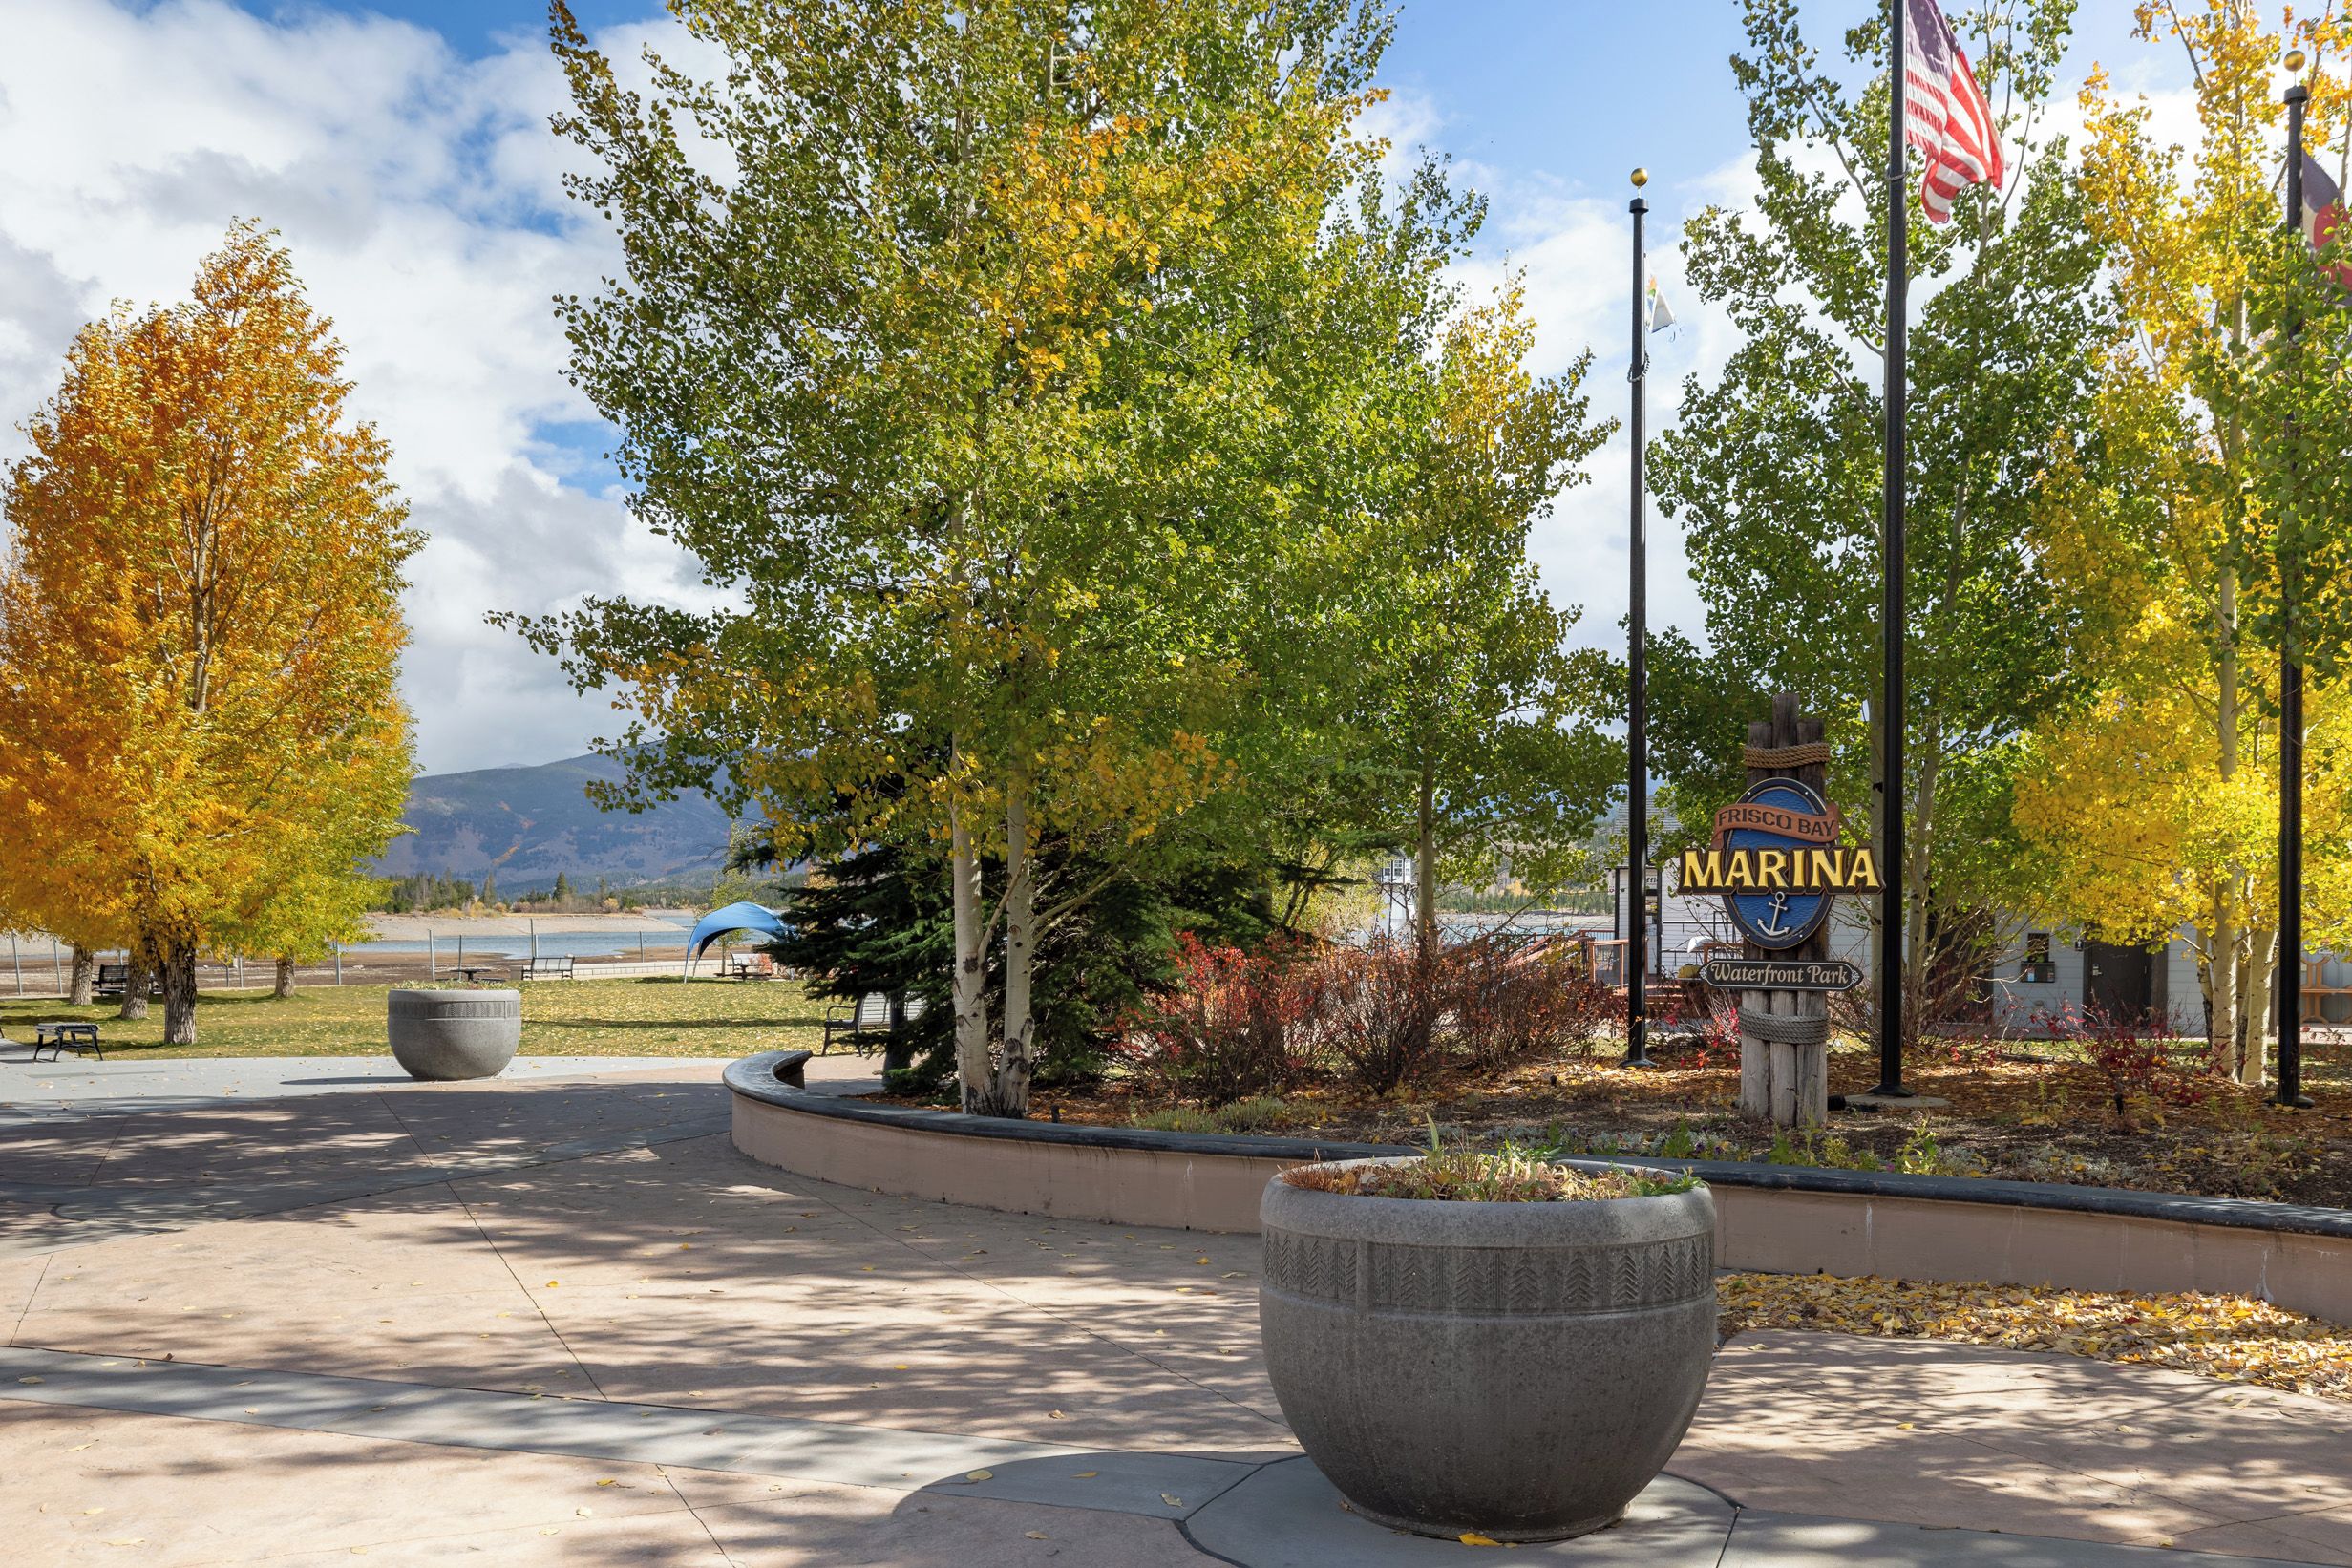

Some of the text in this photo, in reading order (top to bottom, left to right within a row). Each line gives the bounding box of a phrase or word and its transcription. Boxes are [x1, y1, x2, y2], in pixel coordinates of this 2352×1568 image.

[1719, 808, 1835, 837] FRISCO BAY
[1683, 849, 1880, 887] MARINA
[1710, 964, 1849, 985] Waterfront Park
